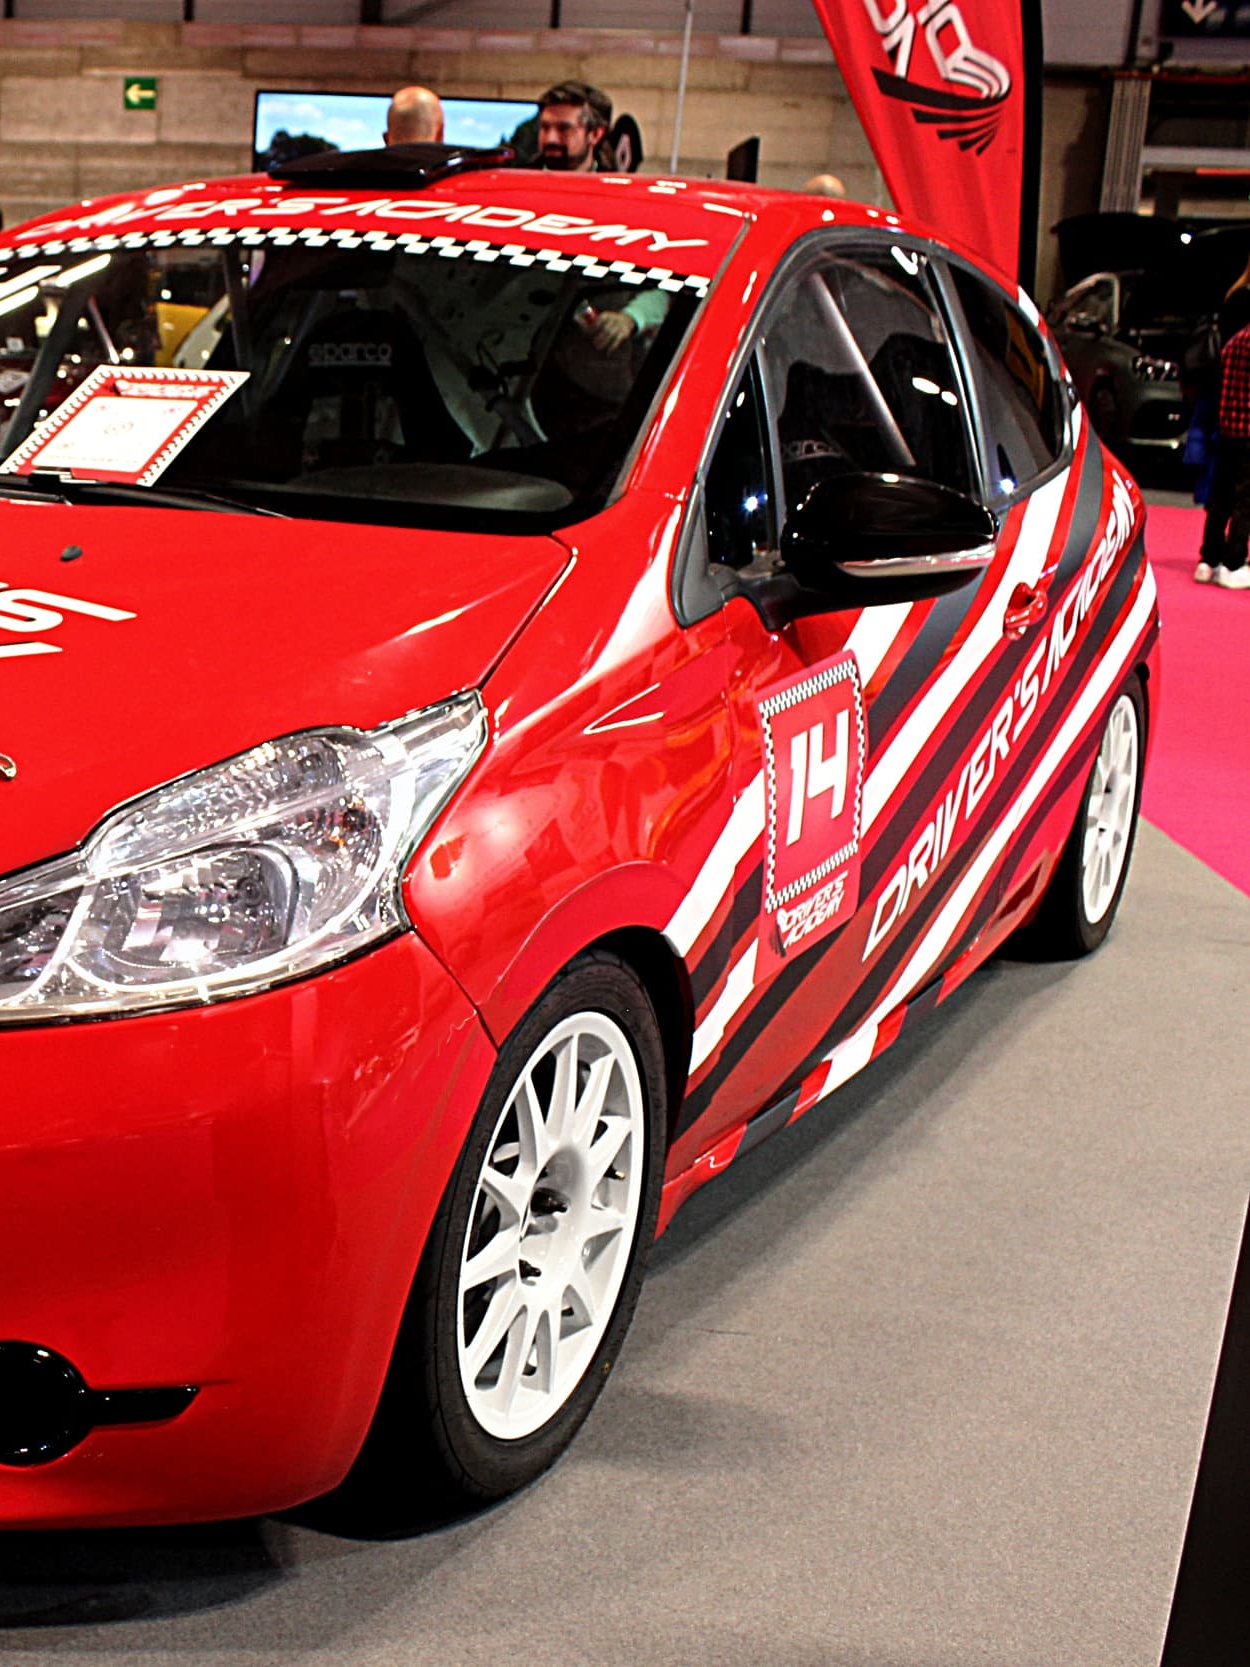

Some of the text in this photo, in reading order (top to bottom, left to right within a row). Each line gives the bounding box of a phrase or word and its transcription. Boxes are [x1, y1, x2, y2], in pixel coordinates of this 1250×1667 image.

[320, 199, 709, 252] ACADEMY
[786, 708, 850, 848] 14
[862, 636, 1048, 963] DRIVER'S
